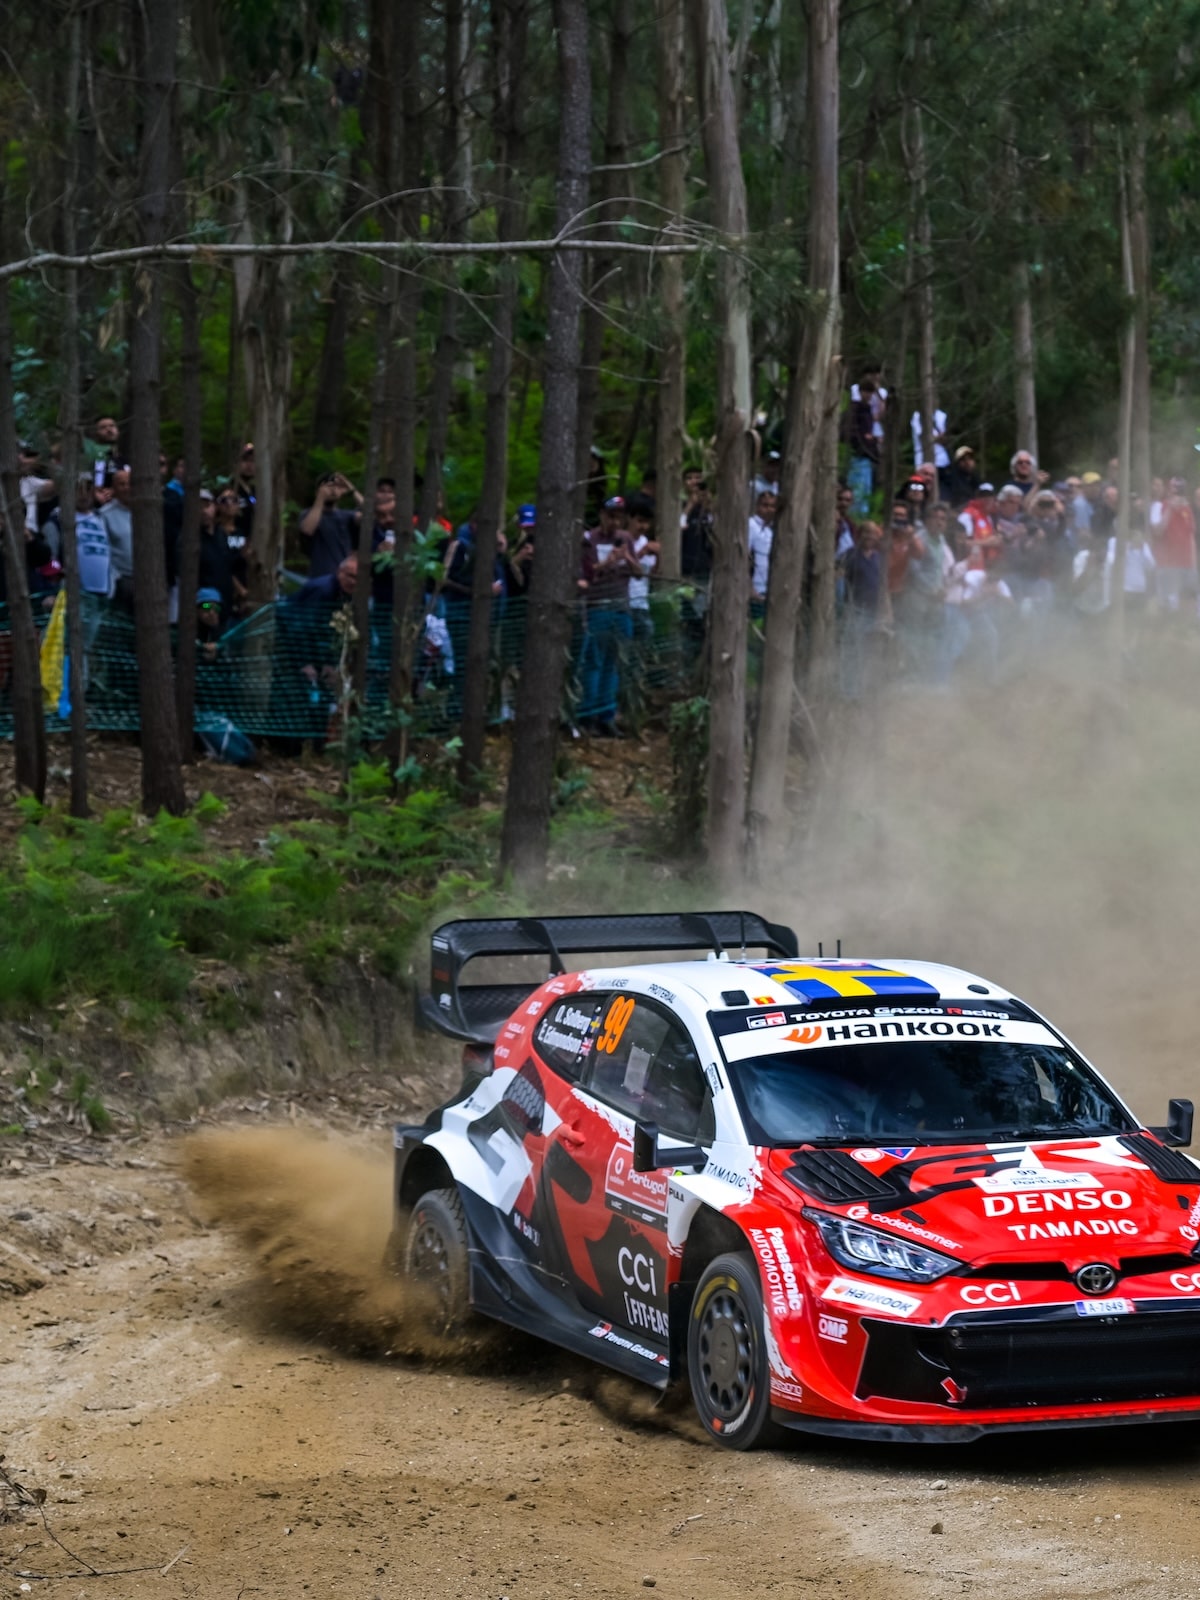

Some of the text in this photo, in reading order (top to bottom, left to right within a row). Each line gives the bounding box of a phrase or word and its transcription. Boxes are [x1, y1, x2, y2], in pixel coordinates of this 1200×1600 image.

[563, 1007, 591, 1035] Solberg
[596, 996, 635, 1054] 99
[790, 1009, 870, 1022] TOYOTA
[874, 1006, 944, 1017] GAZOO
[946, 1007, 1009, 1020] Racing
[628, 1168, 667, 1195] Portugal
[706, 1162, 746, 1188] TAMADIC
[1012, 1177, 1083, 1186] Portugal
[981, 1190, 1133, 1218] DENSO
[870, 1213, 963, 1251] codebeamer
[1007, 1219, 1139, 1241] TAMADIC
[750, 1228, 787, 1315] AUTOMOTIVE
[765, 1227, 801, 1312] Panasonic
[1088, 1301, 1124, 1312] A-7649
[818, 1317, 848, 1338] OMP
[604, 1331, 634, 1349] TOYOTA
[630, 1344, 658, 1360] GAZOO
